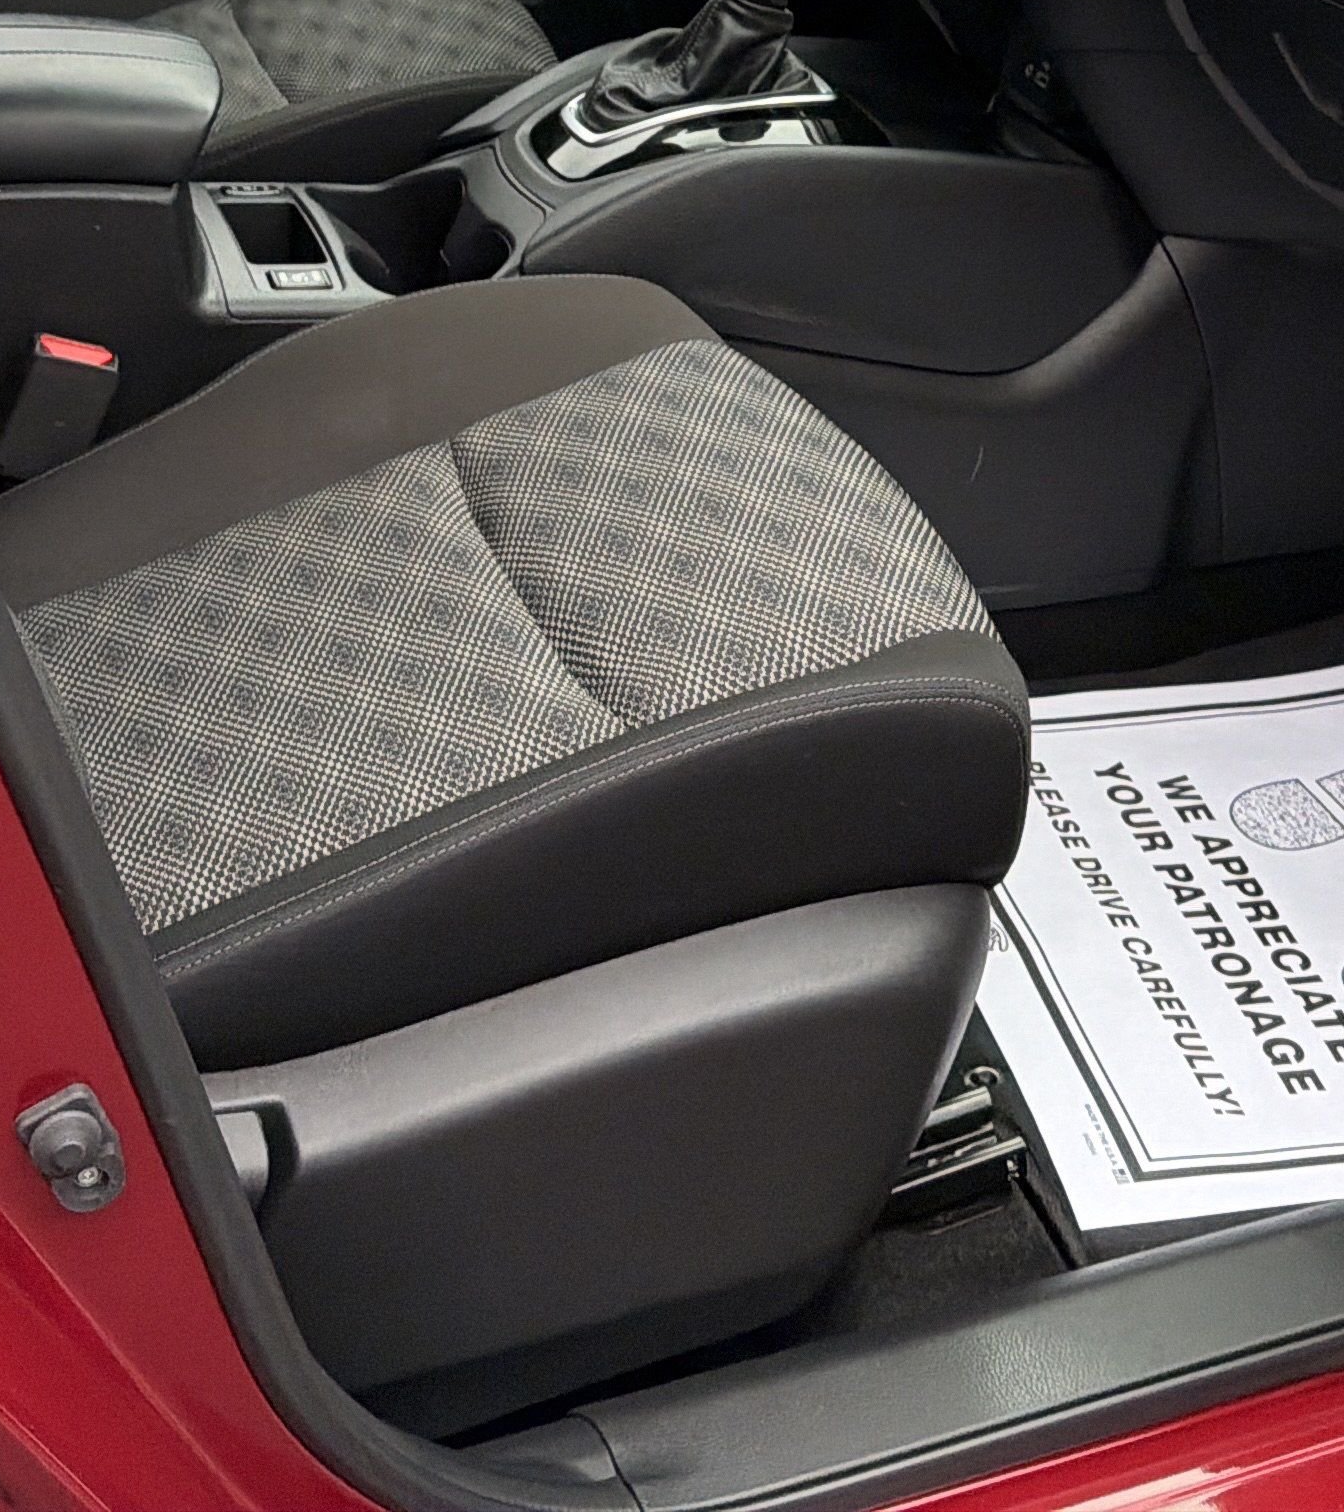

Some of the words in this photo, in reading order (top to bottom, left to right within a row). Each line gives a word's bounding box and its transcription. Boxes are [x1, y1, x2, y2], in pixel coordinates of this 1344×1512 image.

[1029, 761, 1091, 850] PLEASE
[1071, 856, 1141, 930] DRIVE
[1122, 936, 1246, 1117] CAREFULLY!
[1093, 761, 1175, 853] YOUR
[1152, 863, 1327, 1095] PATRONAGE
[1157, 774, 1217, 824] WE
